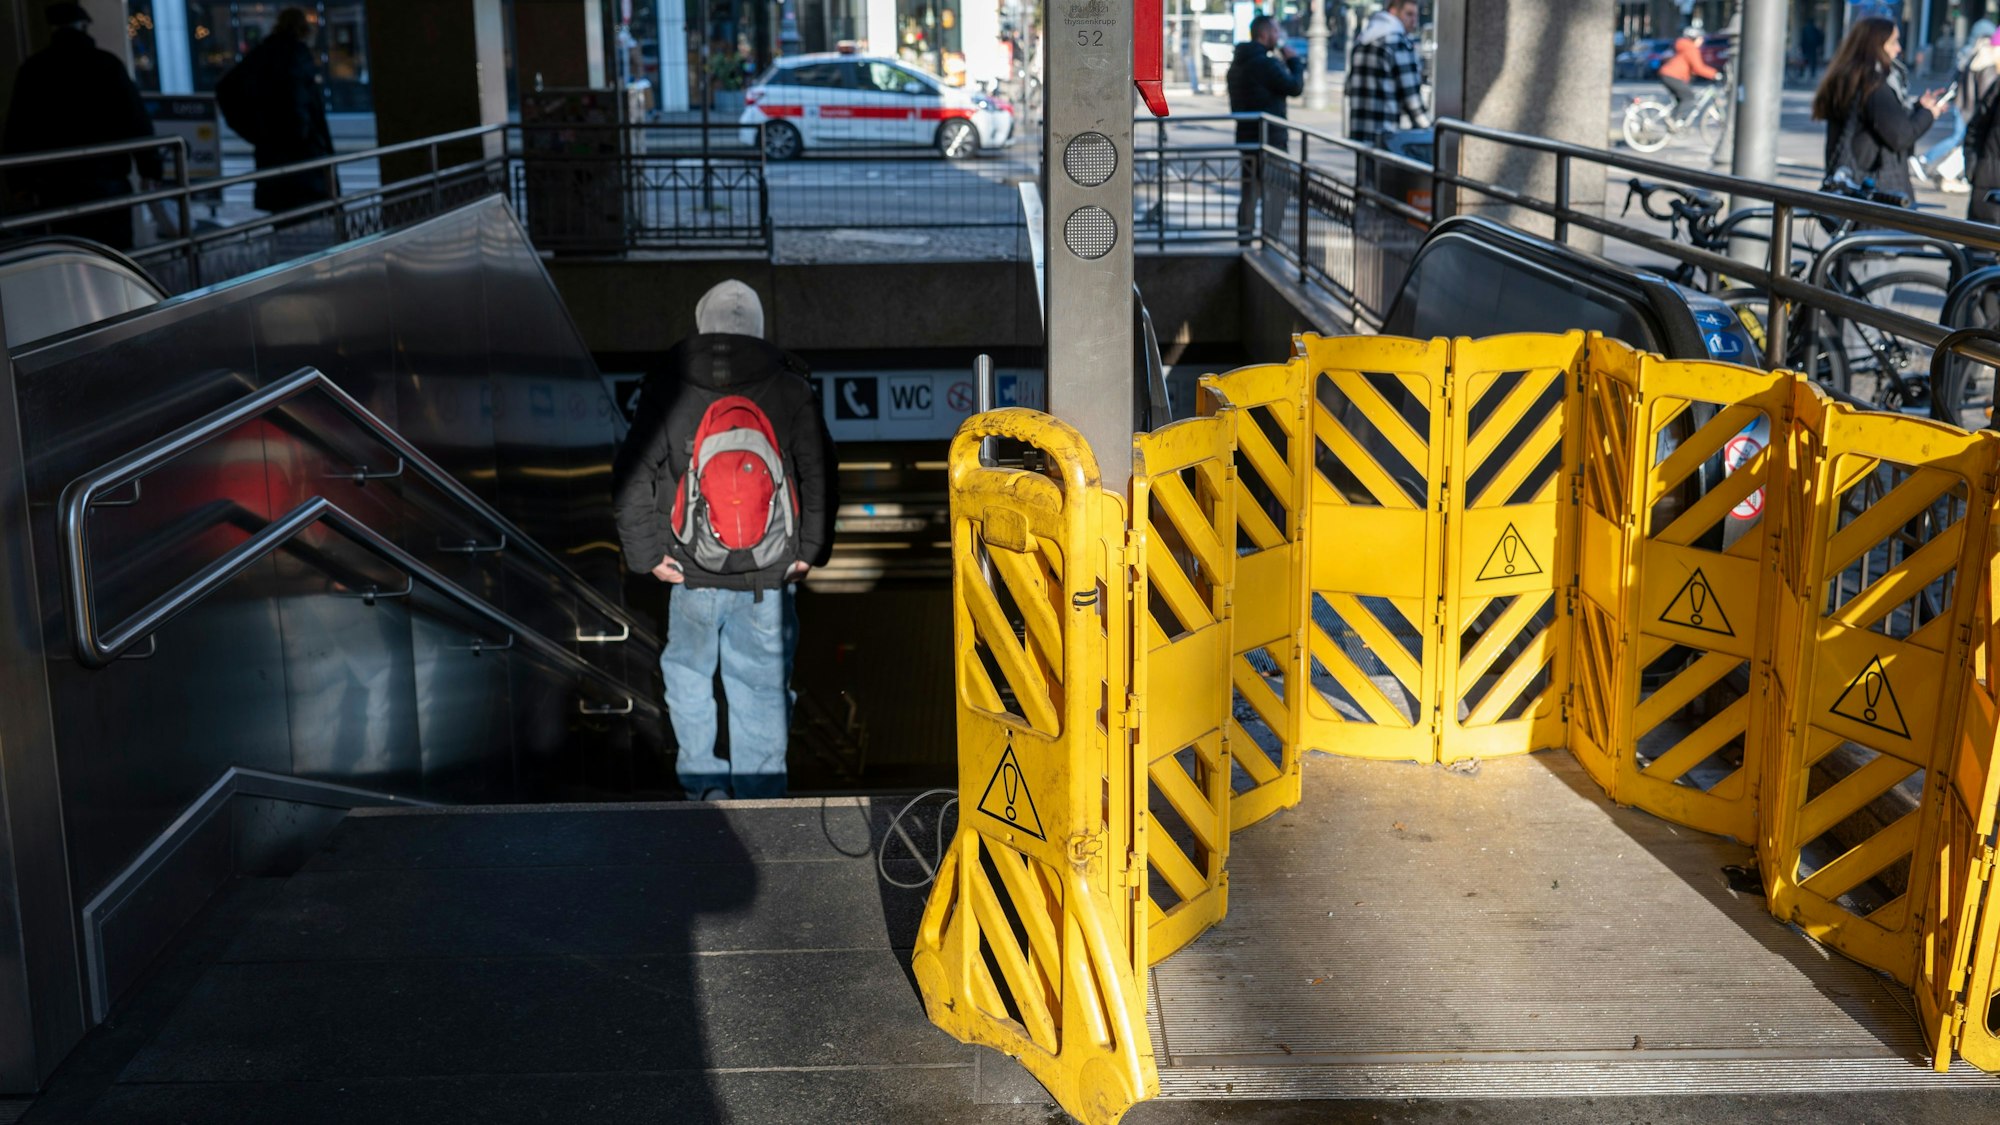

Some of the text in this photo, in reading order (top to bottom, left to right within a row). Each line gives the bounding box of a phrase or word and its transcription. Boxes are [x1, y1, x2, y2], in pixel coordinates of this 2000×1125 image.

[1064, 18, 1117, 26] thyssenkrupp
[1077, 30, 1103, 46] 52
[891, 384, 931, 410] WC
